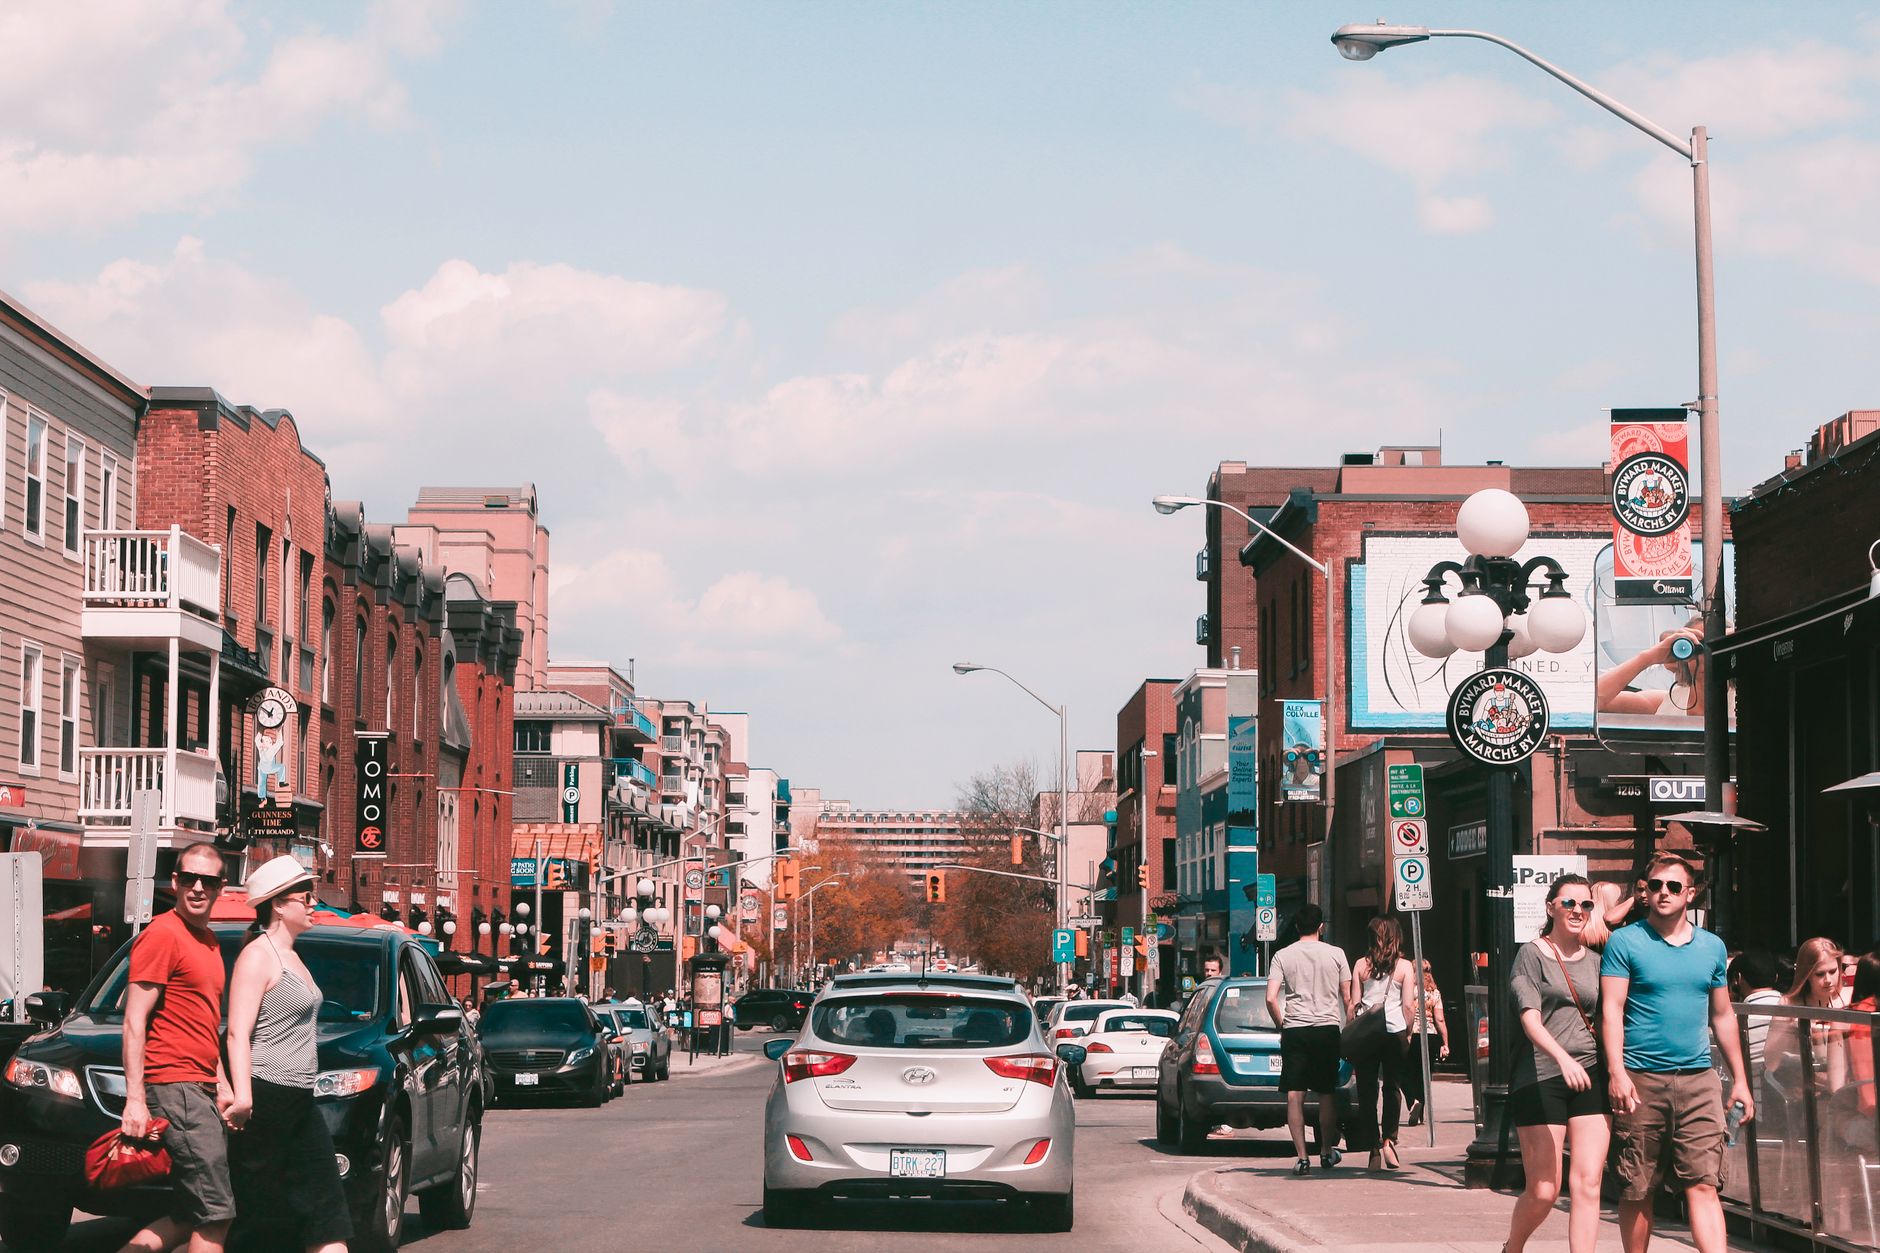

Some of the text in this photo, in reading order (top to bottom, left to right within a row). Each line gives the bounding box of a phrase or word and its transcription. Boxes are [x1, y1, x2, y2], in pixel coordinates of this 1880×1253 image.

[1617, 461, 1684, 495] BYWARD MARKET
[1623, 507, 1677, 529] MARCHÉ BY
[1623, 532, 1632, 555] BYW
[1459, 674, 1543, 716] BYWARD MARKET
[1465, 734, 1535, 760] MARCHÉ BY
[363, 741, 382, 821] TOMO
[1617, 785, 1641, 796] 1205
[1655, 781, 1705, 799] OUT
[252, 811, 292, 819] GUINNESS
[262, 818, 282, 827] TIME
[1408, 864, 1417, 878] P
[1405, 884, 1411, 892] 2
[1263, 912, 1270, 920] P
[1057, 932, 1070, 949] P
[925, 1157, 943, 1171] 227
